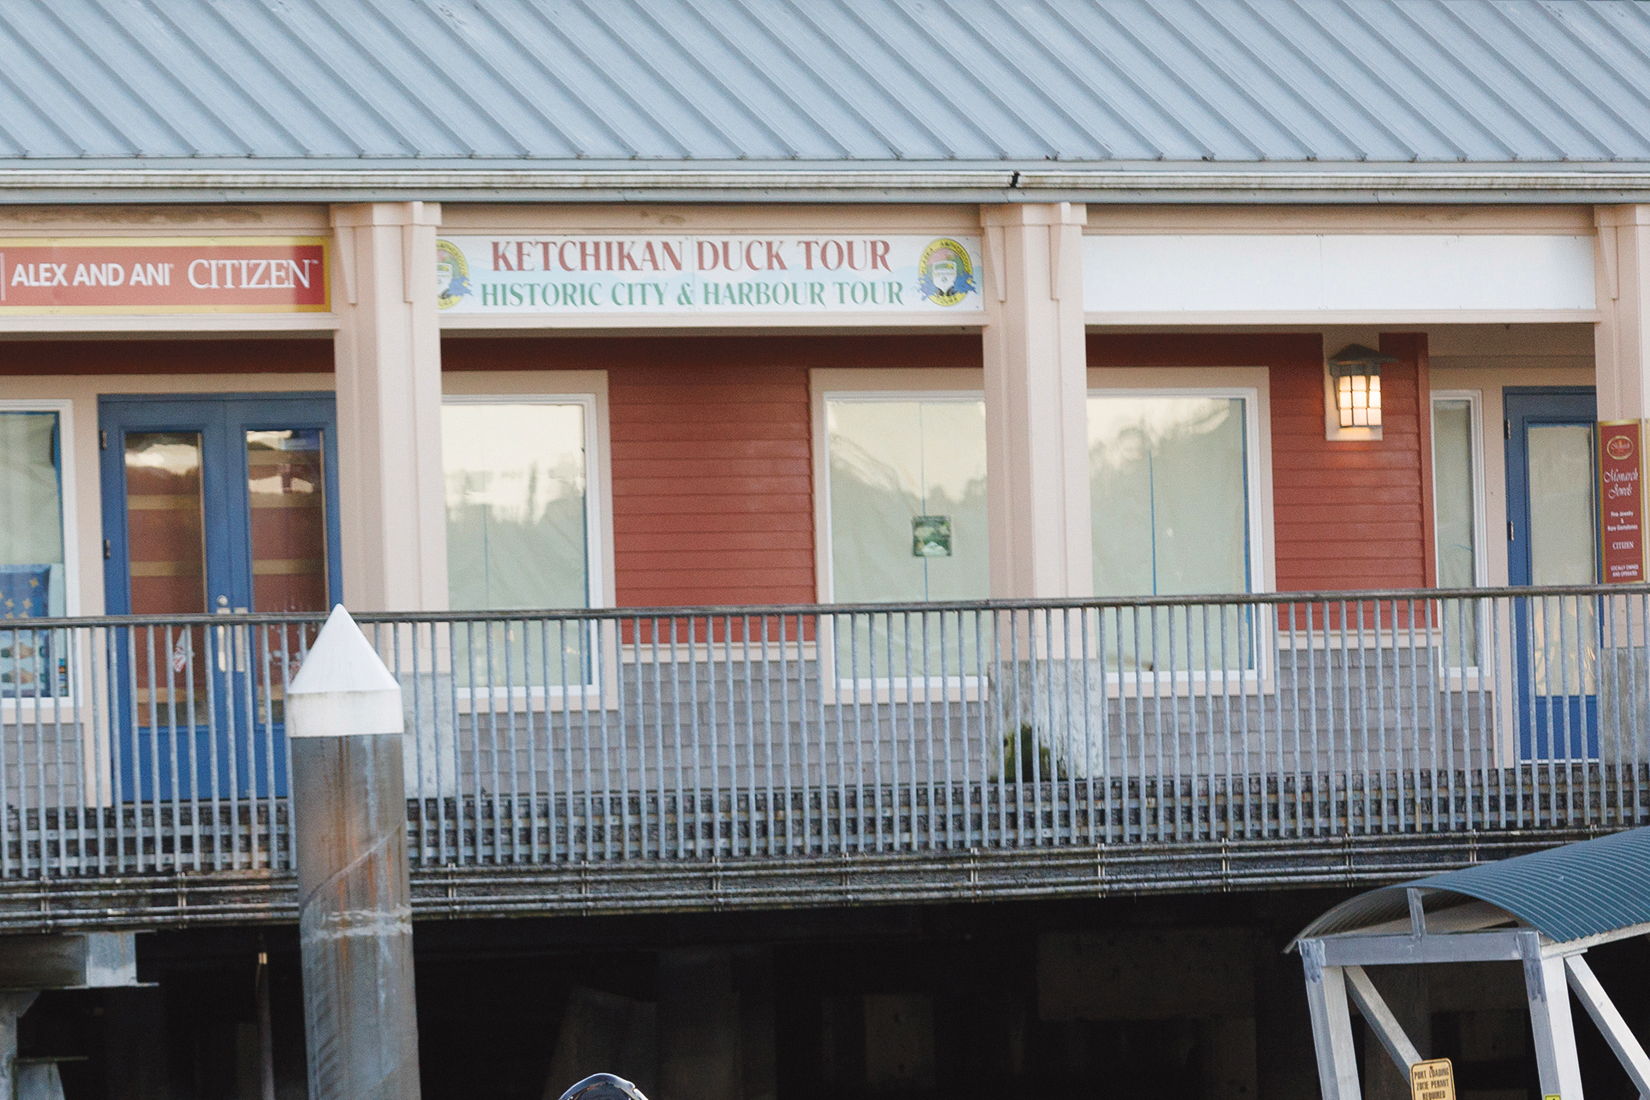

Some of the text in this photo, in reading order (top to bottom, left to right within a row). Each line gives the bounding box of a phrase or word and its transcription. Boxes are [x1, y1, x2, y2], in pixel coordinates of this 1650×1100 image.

[492, 240, 683, 271] KETCHIKAN
[696, 240, 789, 271] DUCK
[798, 240, 893, 273] TOUR
[10, 263, 173, 287] ALEX AND ANI
[187, 258, 314, 290] CITIZEN
[481, 281, 905, 308] HISTORIC CITY & HARBOUR TOUR
[1604, 467, 1639, 484] Monarch
[1414, 1070, 1426, 1080] PORT
[1422, 1091, 1446, 1100] REQUIRED
